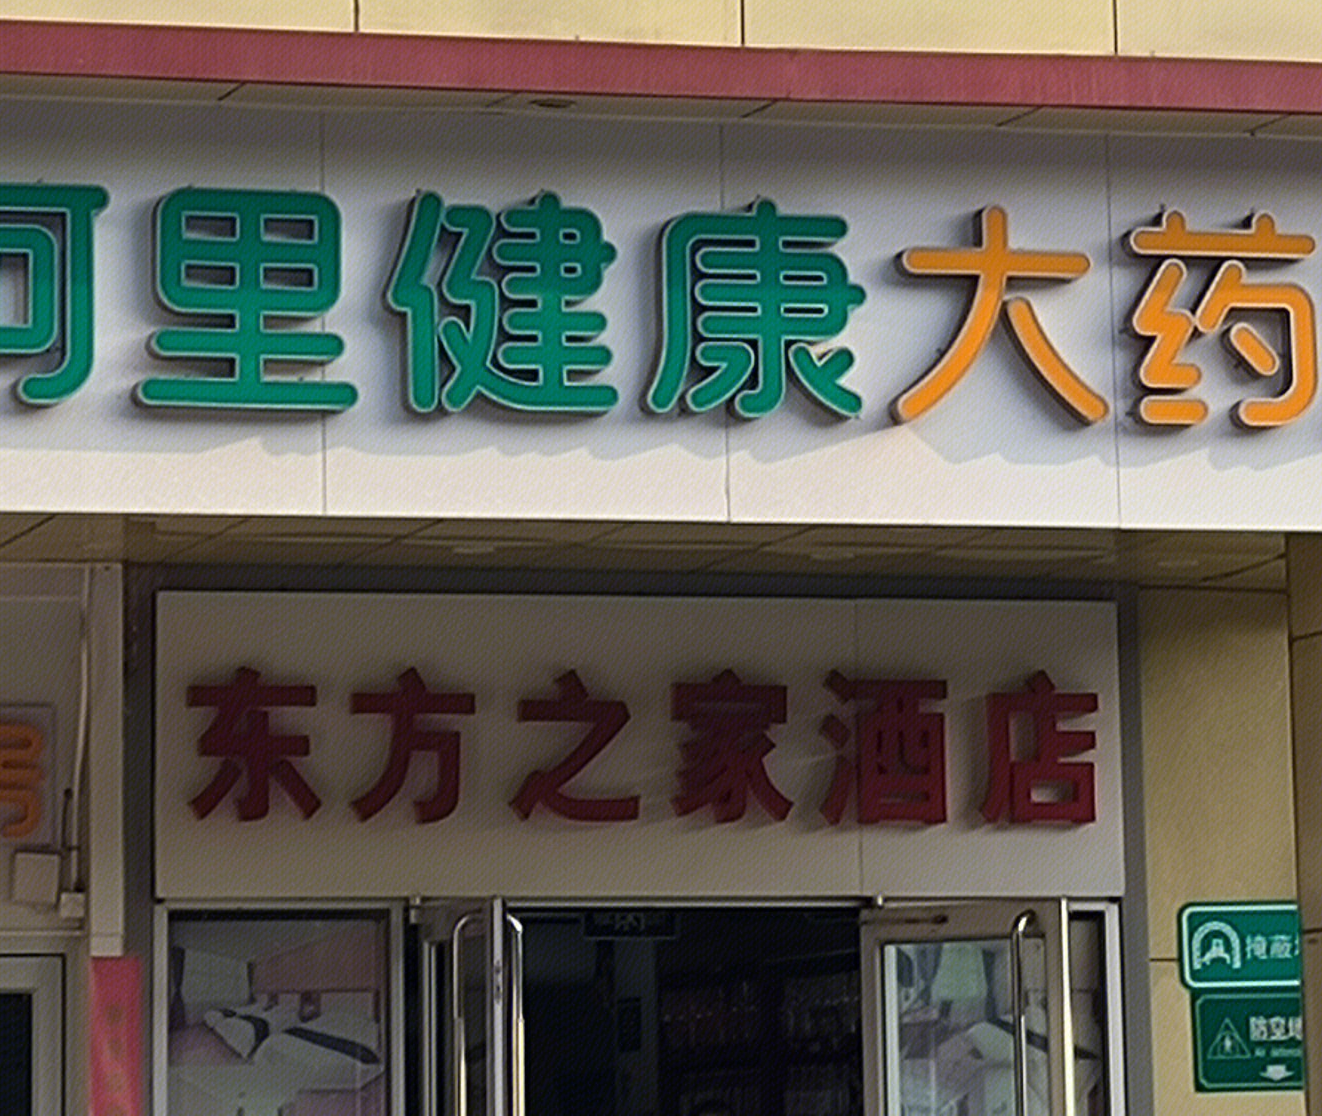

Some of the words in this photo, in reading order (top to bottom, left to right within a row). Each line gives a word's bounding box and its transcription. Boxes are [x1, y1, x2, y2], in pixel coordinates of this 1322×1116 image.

[184, 665, 1101, 828] 东方之家酒店
